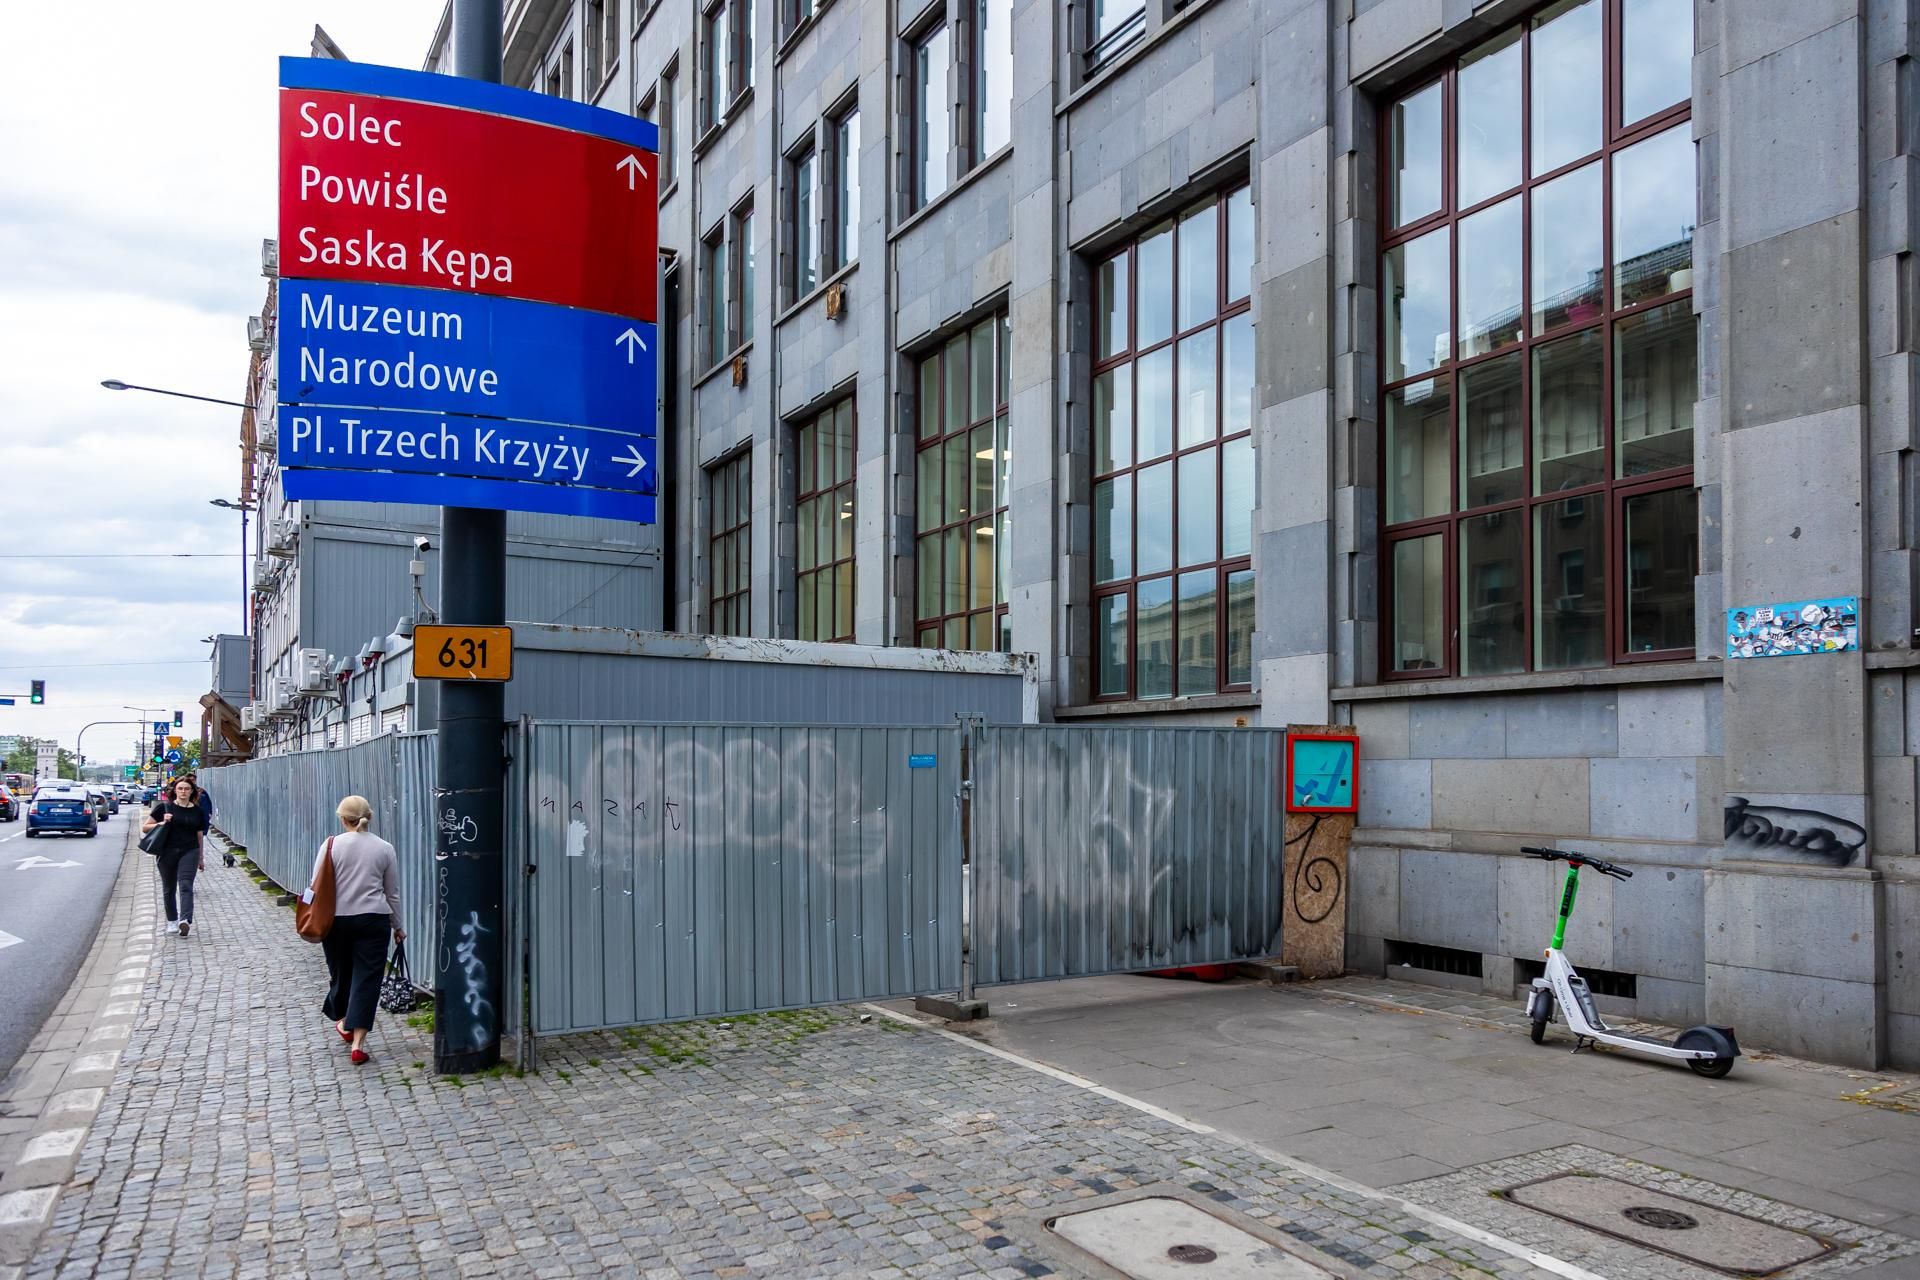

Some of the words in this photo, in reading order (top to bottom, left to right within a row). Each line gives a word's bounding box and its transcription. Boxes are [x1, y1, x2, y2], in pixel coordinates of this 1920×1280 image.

[299, 101, 402, 147] Solec
[300, 164, 447, 214] Powiśle
[299, 226, 407, 270] Saska
[421, 237, 513, 289] Kępa
[301, 292, 462, 340] Muzeum
[300, 346, 498, 396] Narodowe
[475, 428, 590, 481] Krzyży
[438, 637, 489, 669] 631
